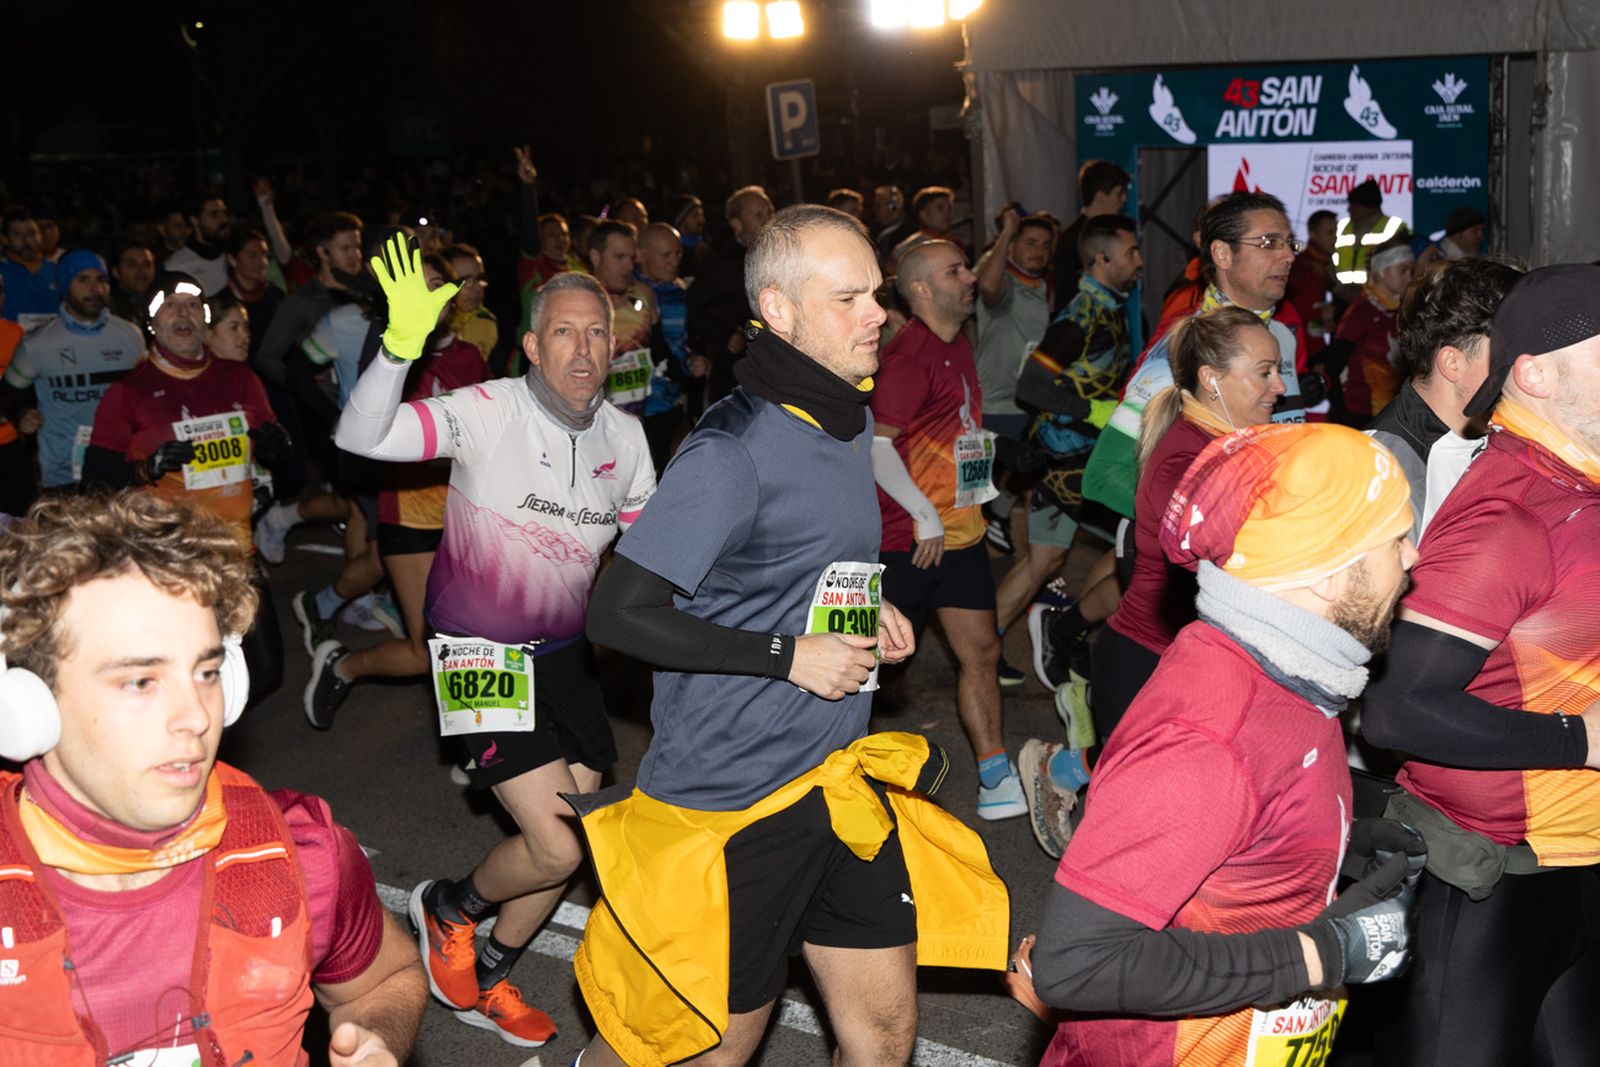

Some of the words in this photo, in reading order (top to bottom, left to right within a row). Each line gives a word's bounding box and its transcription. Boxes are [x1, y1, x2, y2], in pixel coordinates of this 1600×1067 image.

[779, 91, 807, 150] P
[1214, 101, 1318, 138] ANTÓN
[1358, 106, 1380, 128] 43
[1416, 175, 1482, 189] calderón
[195, 437, 243, 465] 3008
[517, 493, 566, 517] SIERRA
[821, 591, 844, 606] SAN
[443, 660, 459, 669] SAN
[460, 656, 495, 669] ANTÓN
[451, 646, 481, 657] NOCHE
[482, 647, 495, 657] DE
[449, 670, 515, 700] 6820
[1272, 1015, 1307, 1034] SAN
